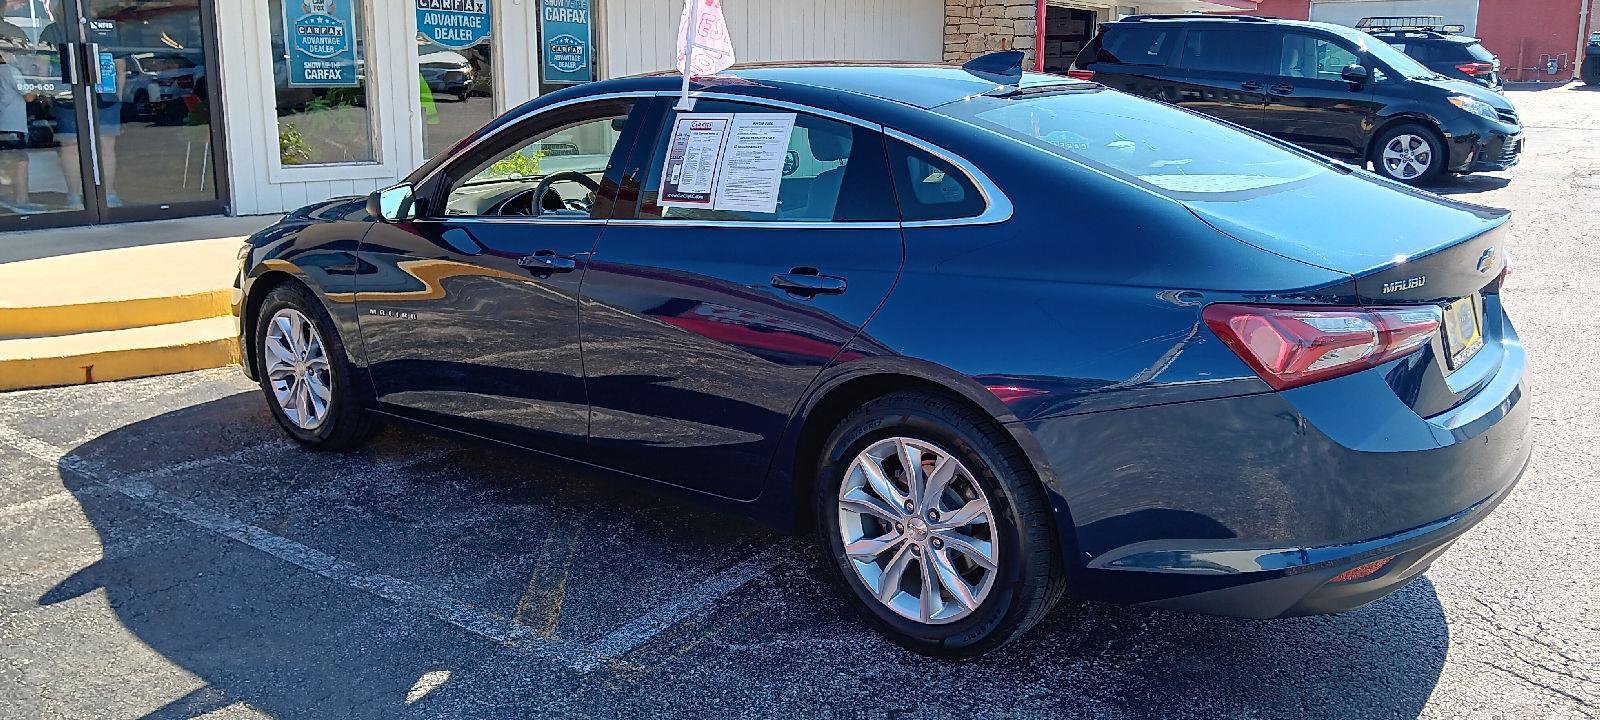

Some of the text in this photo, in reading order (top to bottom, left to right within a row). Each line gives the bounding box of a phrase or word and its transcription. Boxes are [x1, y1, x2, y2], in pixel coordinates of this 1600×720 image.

[418, 0, 483, 13] CARFAX
[424, 13, 481, 28] ADVANTAGE
[545, 7, 586, 23] CARFAX
[299, 27, 343, 35] CARFAX
[434, 27, 472, 40] DEALER
[302, 36, 340, 45] ADVANTAGE
[551, 45, 582, 54] CARFAX
[304, 69, 341, 80] CARFAX
[1383, 276, 1426, 294] MALIBU
